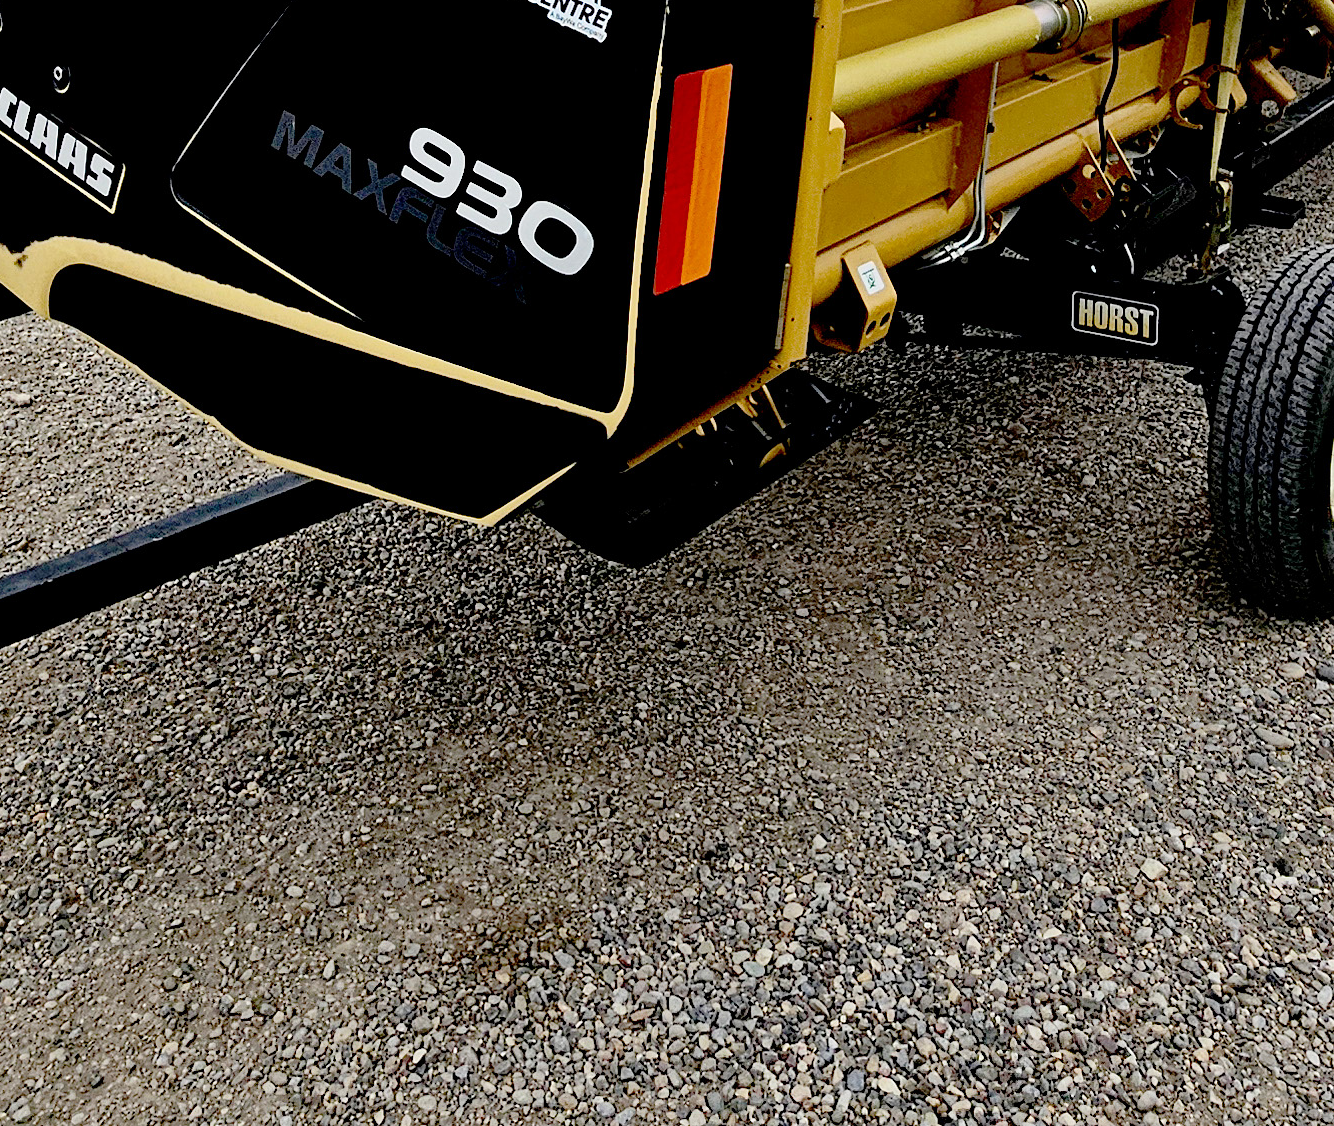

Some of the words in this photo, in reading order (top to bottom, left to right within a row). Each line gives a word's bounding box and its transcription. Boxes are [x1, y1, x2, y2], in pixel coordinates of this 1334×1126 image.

[577, 22, 604, 40] Company
[270, 109, 529, 305] MAXFLEX
[400, 127, 595, 276] 930
[1078, 297, 1155, 339] HORST
